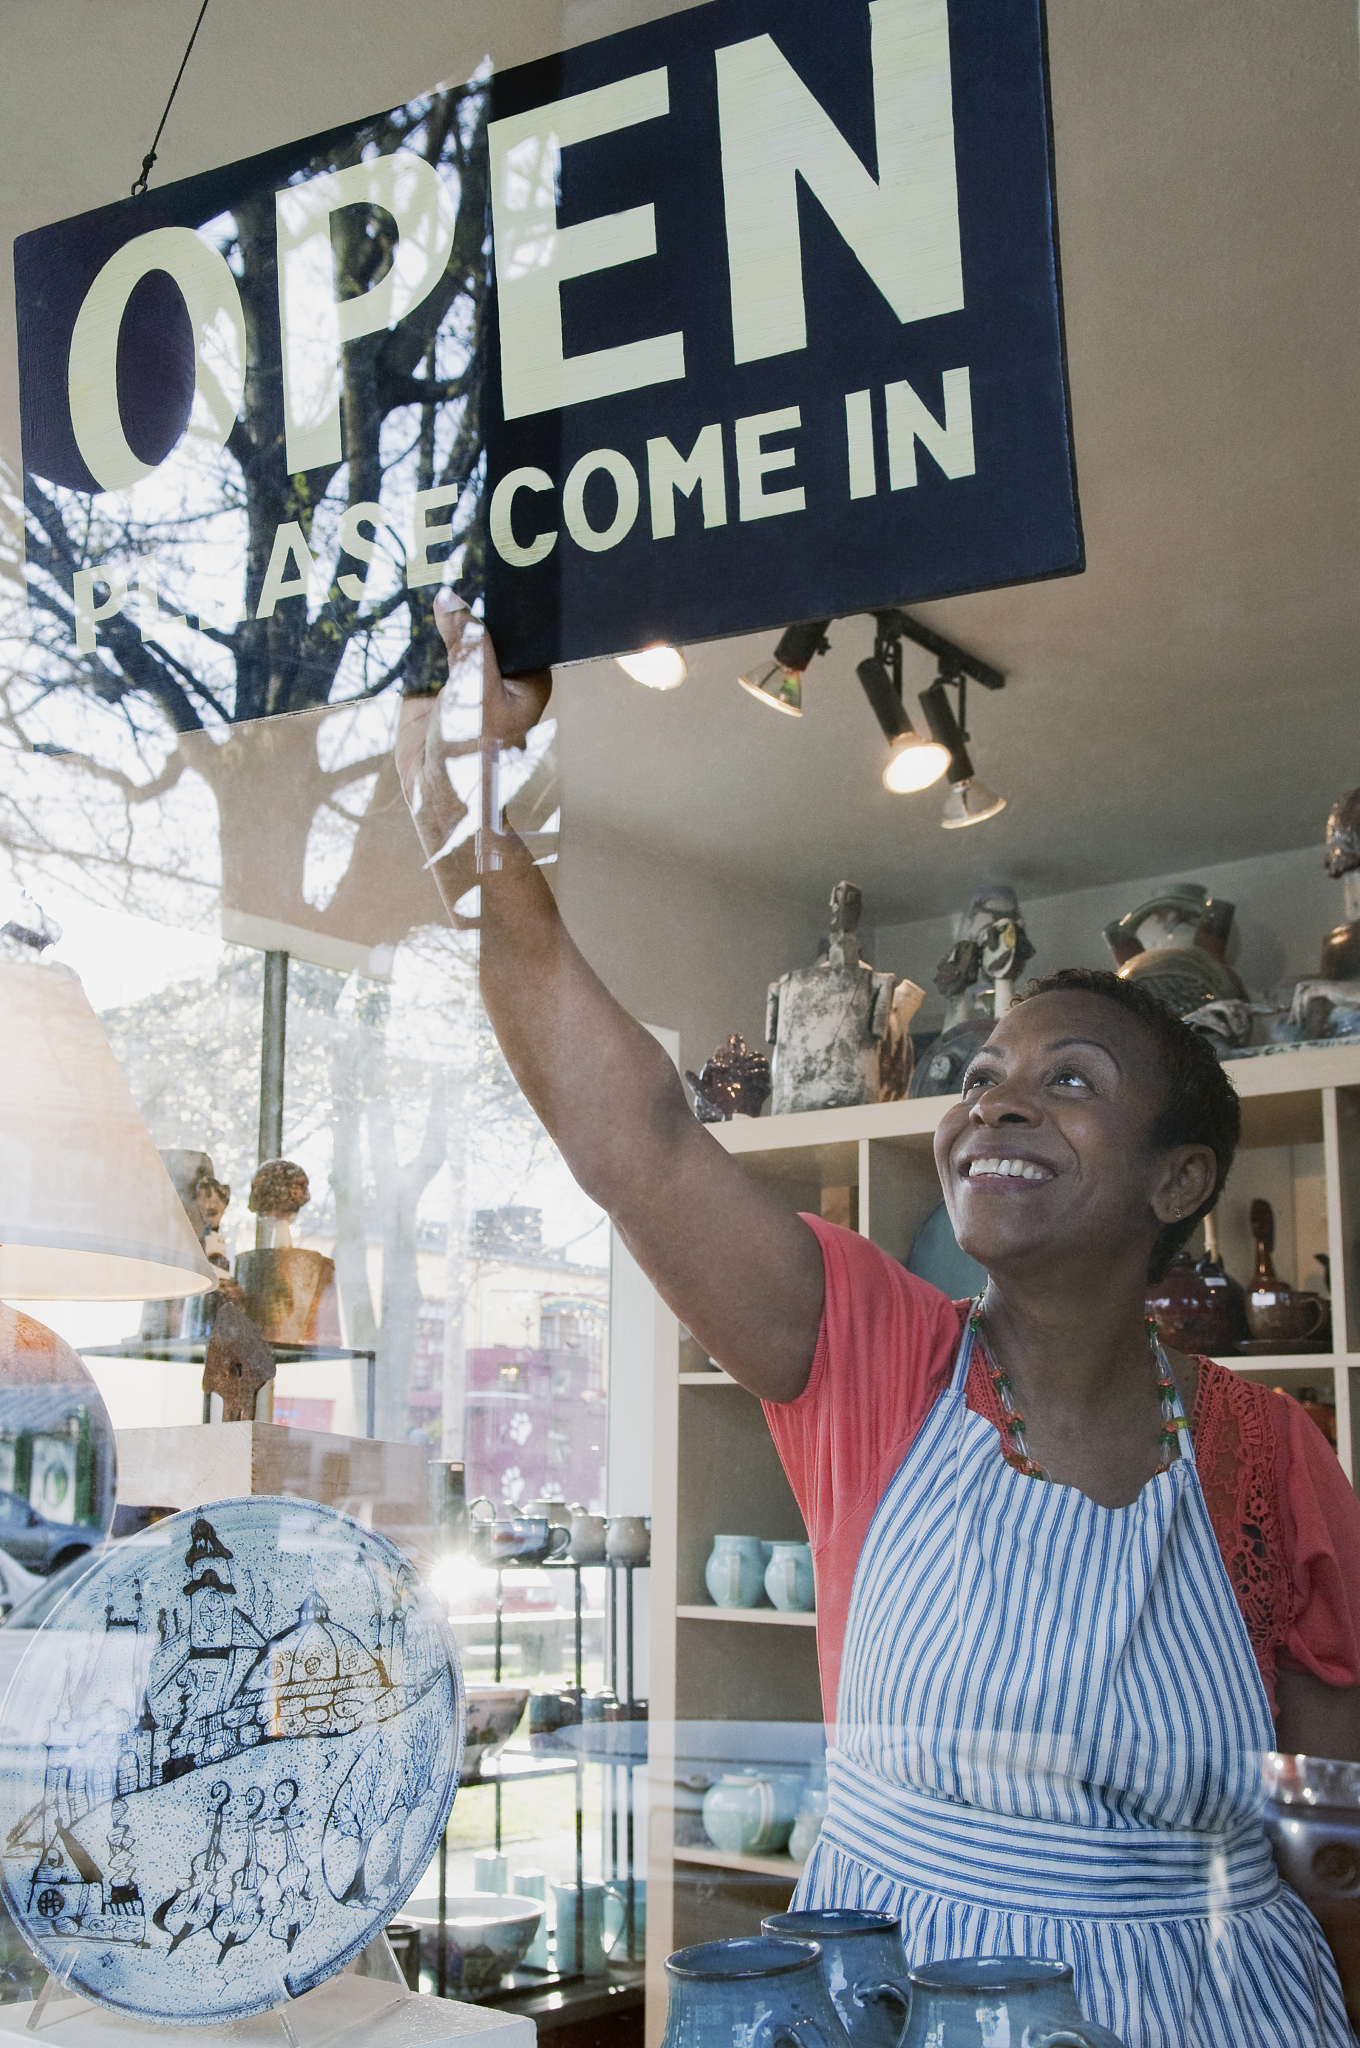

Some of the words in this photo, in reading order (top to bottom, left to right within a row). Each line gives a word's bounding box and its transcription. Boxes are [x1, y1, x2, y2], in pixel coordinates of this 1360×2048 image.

[67, 0, 965, 495] OPEN
[489, 405, 806, 567] COME
[845, 366, 976, 500] IN
